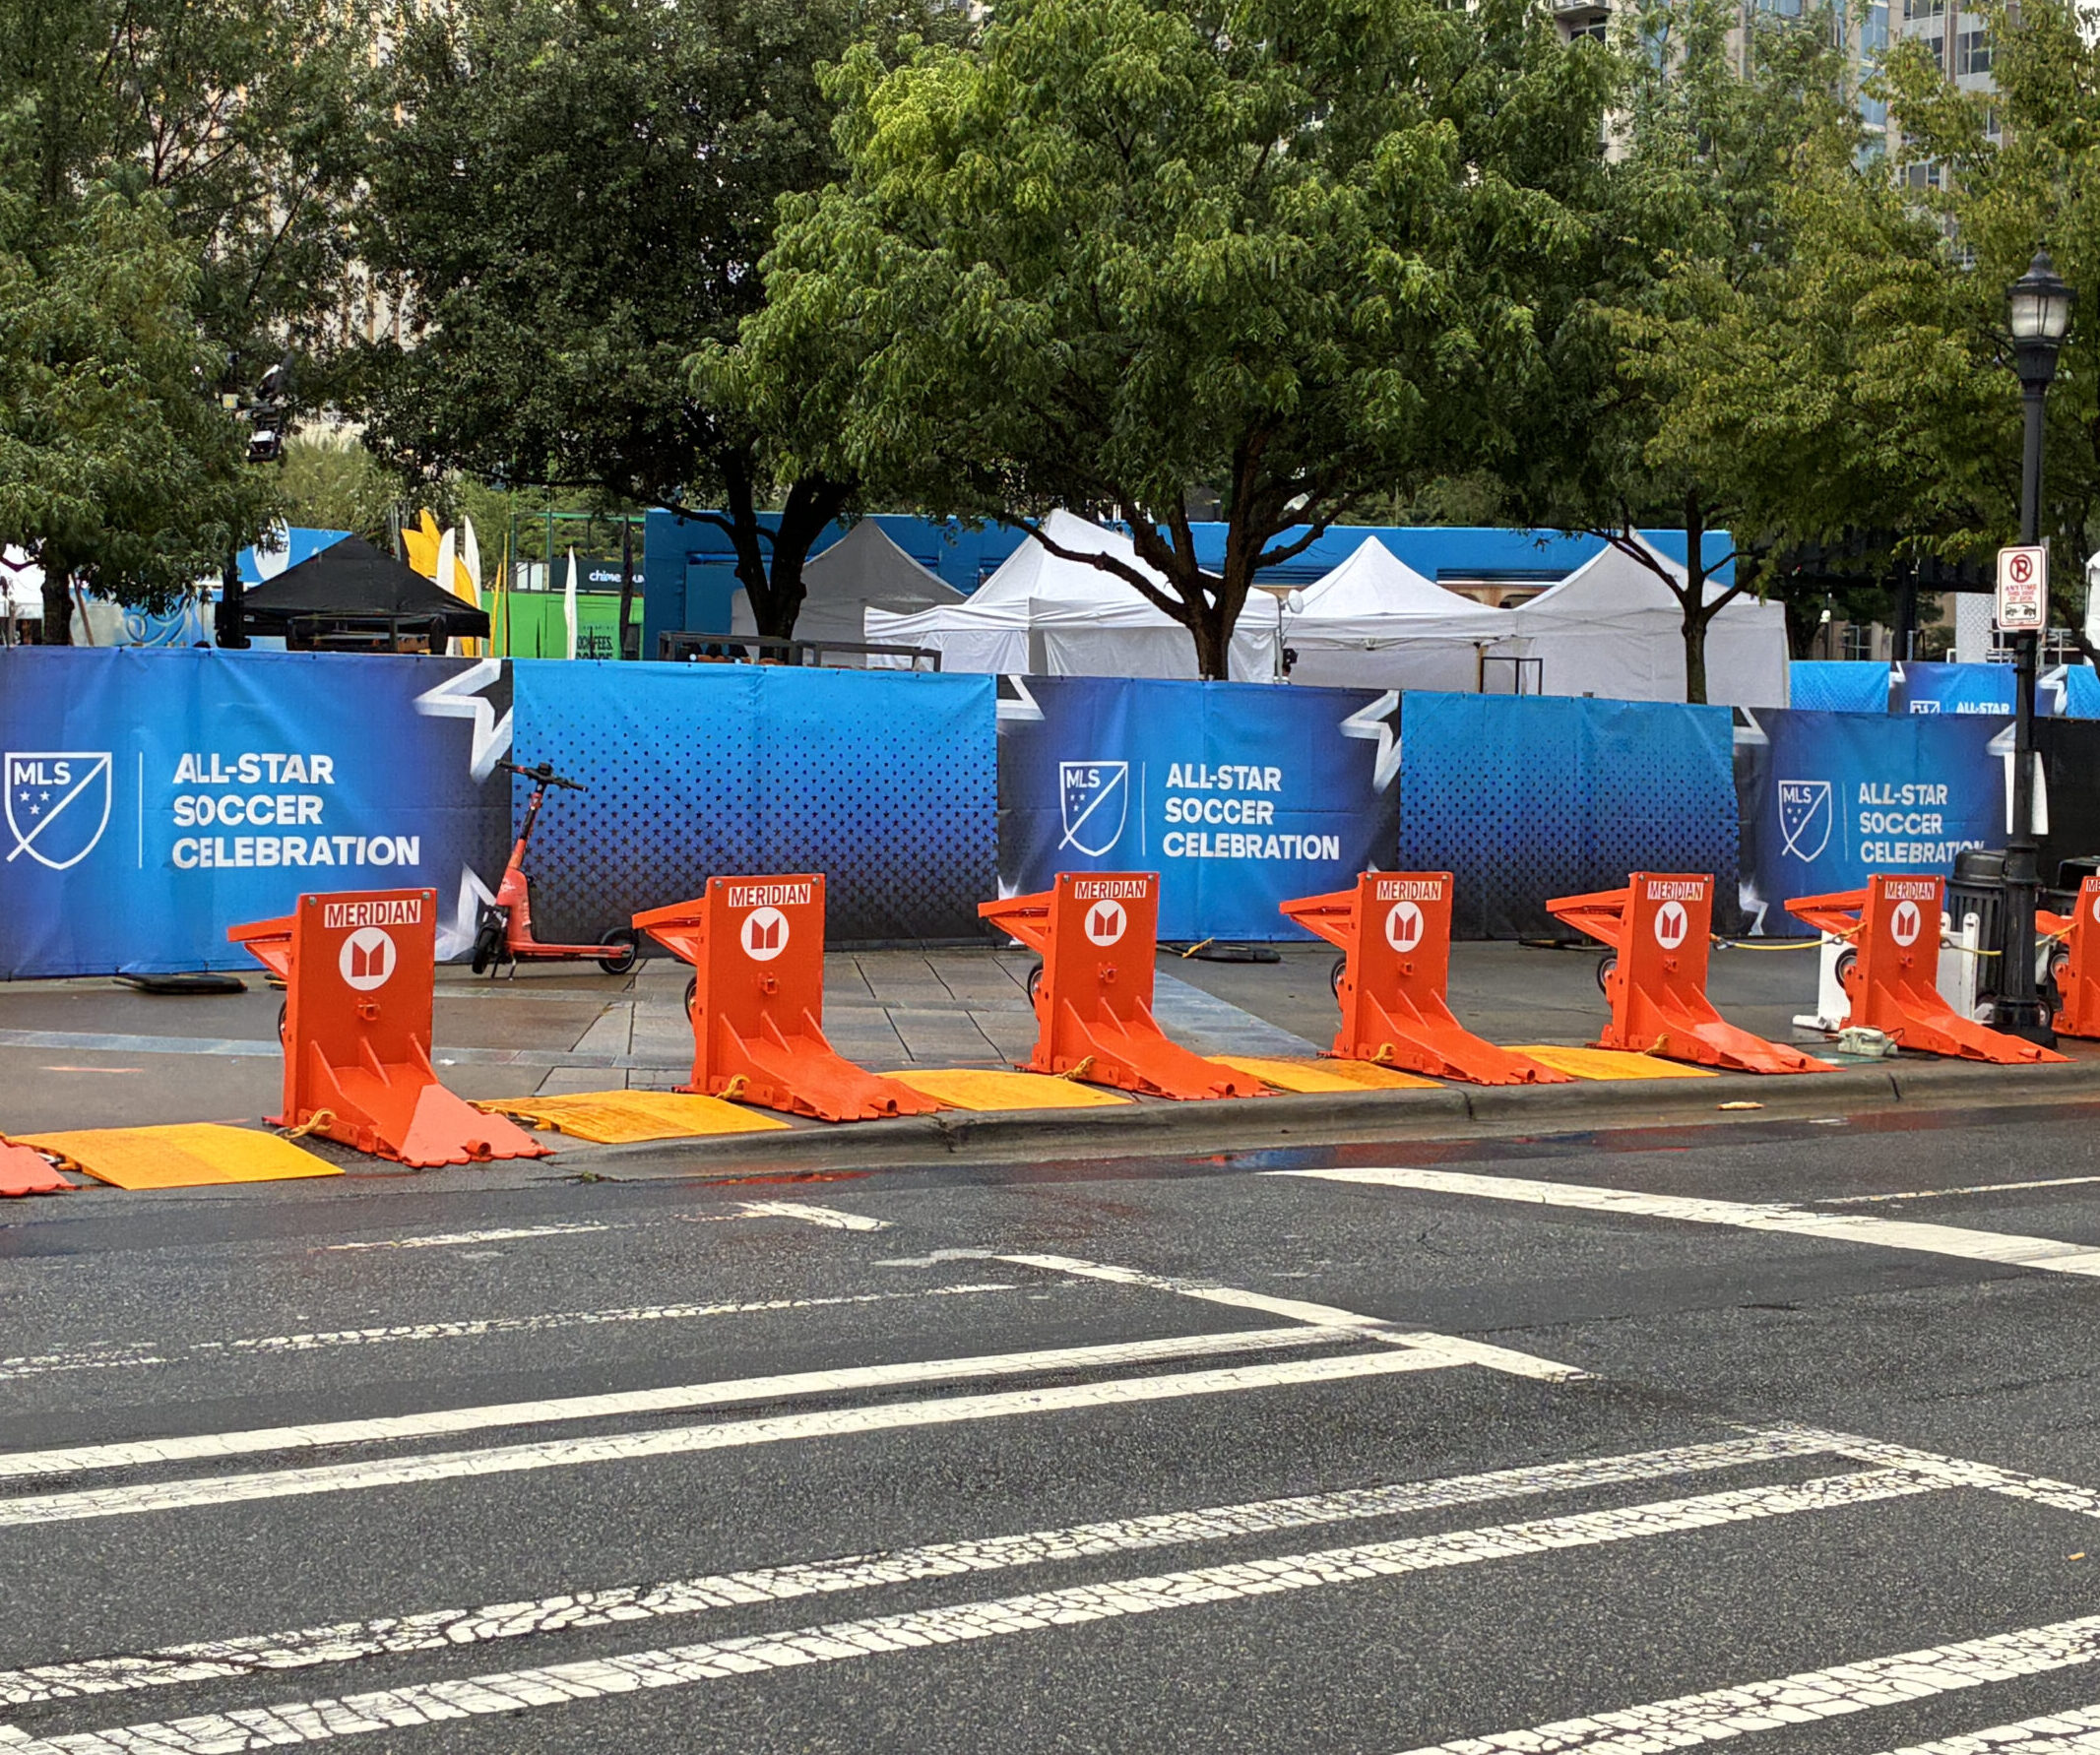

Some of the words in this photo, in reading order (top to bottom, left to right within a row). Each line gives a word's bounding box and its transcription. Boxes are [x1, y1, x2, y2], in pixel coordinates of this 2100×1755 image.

[589, 570, 622, 583] chime
[1956, 702, 2010, 715] ALL-STAR
[14, 761, 71, 786] MLS
[172, 752, 336, 784] ALL-STAR
[1065, 769, 1101, 788] MLS
[1166, 763, 1282, 791] ALL-STAR
[1783, 786, 1813, 804] MLS
[1859, 783, 1948, 806] ALL-STAR
[172, 794, 324, 827] SOCCER
[1165, 797, 1275, 825] SOCCER
[1860, 812, 1943, 835] SOCCER
[171, 836, 421, 869] CELEBRATION
[1163, 832, 1340, 860] CELEBRATION
[732, 884, 808, 907] MERIDIAN
[1077, 880, 1144, 898] MERIDIAN
[1378, 881, 1440, 899] MERIDIAN
[1648, 883, 1702, 899] MERIDIAN
[1886, 882, 1935, 899] MERIDIAN
[327, 899, 419, 927] MERIDIAN
